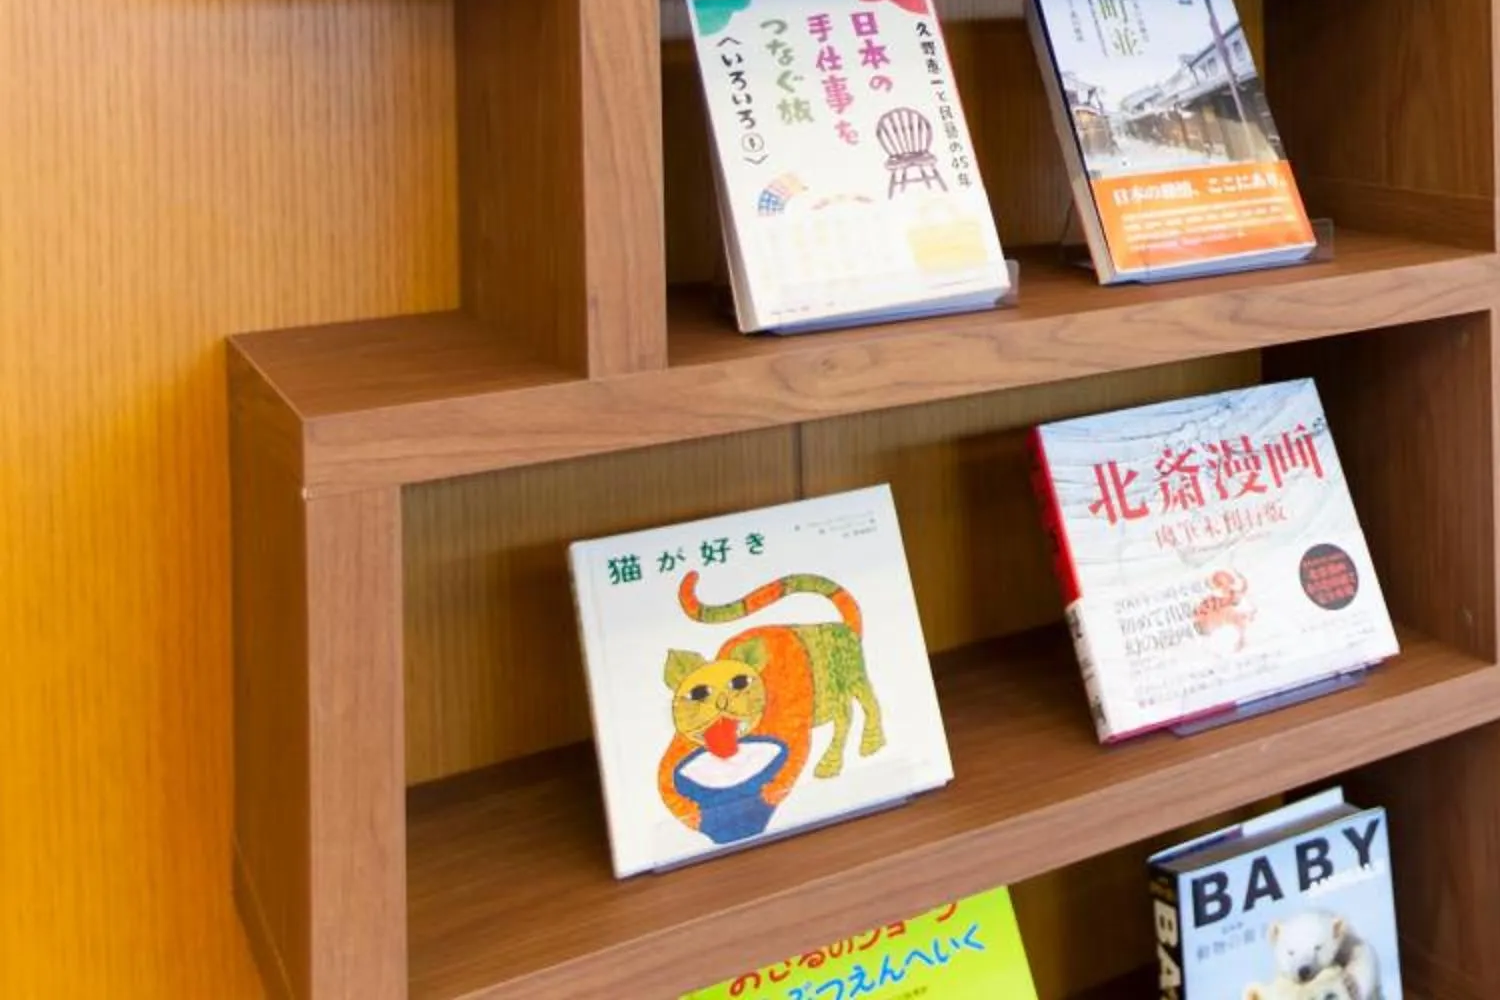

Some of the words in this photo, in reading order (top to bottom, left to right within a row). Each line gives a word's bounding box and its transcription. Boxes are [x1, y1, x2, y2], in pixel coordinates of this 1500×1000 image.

[760, 18, 815, 125] つなぐ旅
[807, 13, 860, 146] 手仕事を
[850, 11, 894, 92] 日本の
[607, 531, 766, 586] 猫が好き
[1191, 817, 1381, 929] BABY
[1153, 899, 1181, 1000] BA
